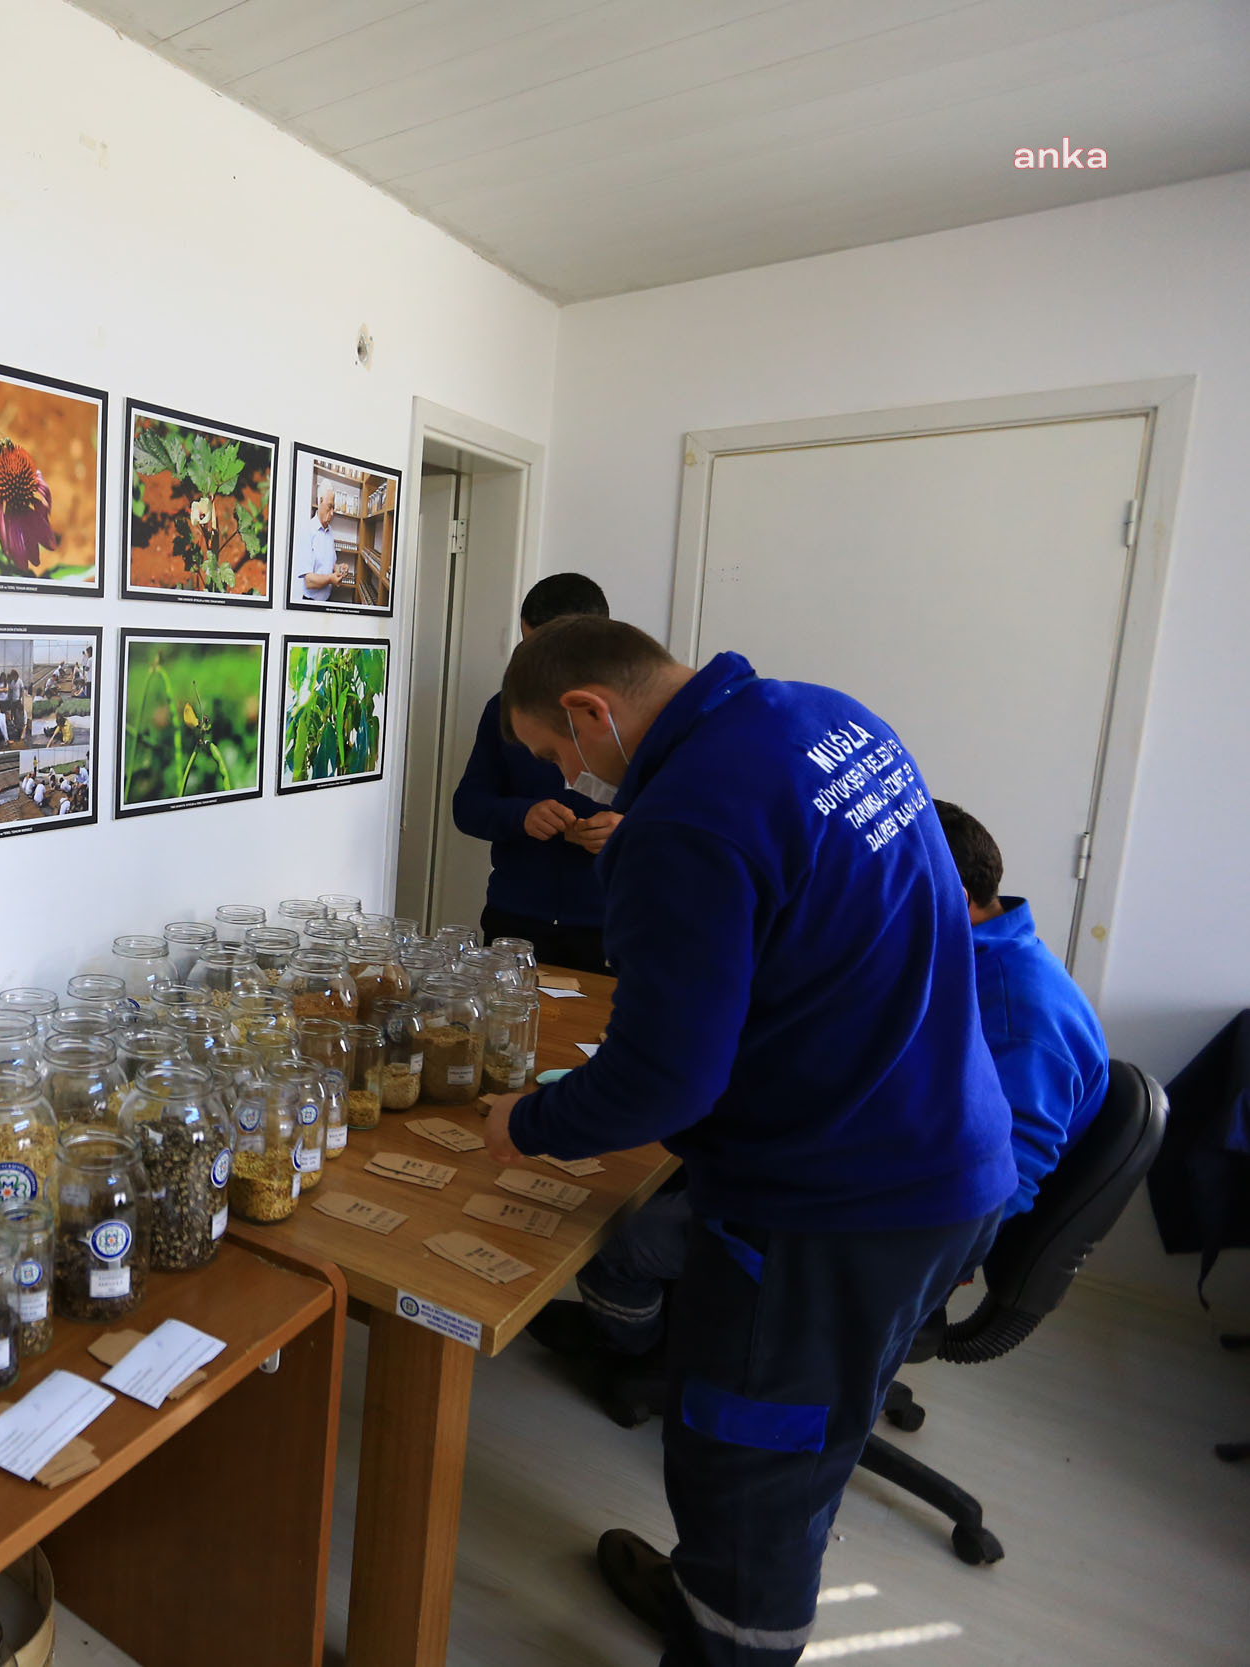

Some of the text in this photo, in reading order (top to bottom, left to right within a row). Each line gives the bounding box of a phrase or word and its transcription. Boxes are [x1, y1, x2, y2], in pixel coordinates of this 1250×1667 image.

[807, 721, 874, 774] MUĞLA
[812, 761, 870, 817] BÜYÜKŞEİR
[844, 789, 889, 830] TARIMSAL
[865, 811, 902, 853] DAİRESİ
